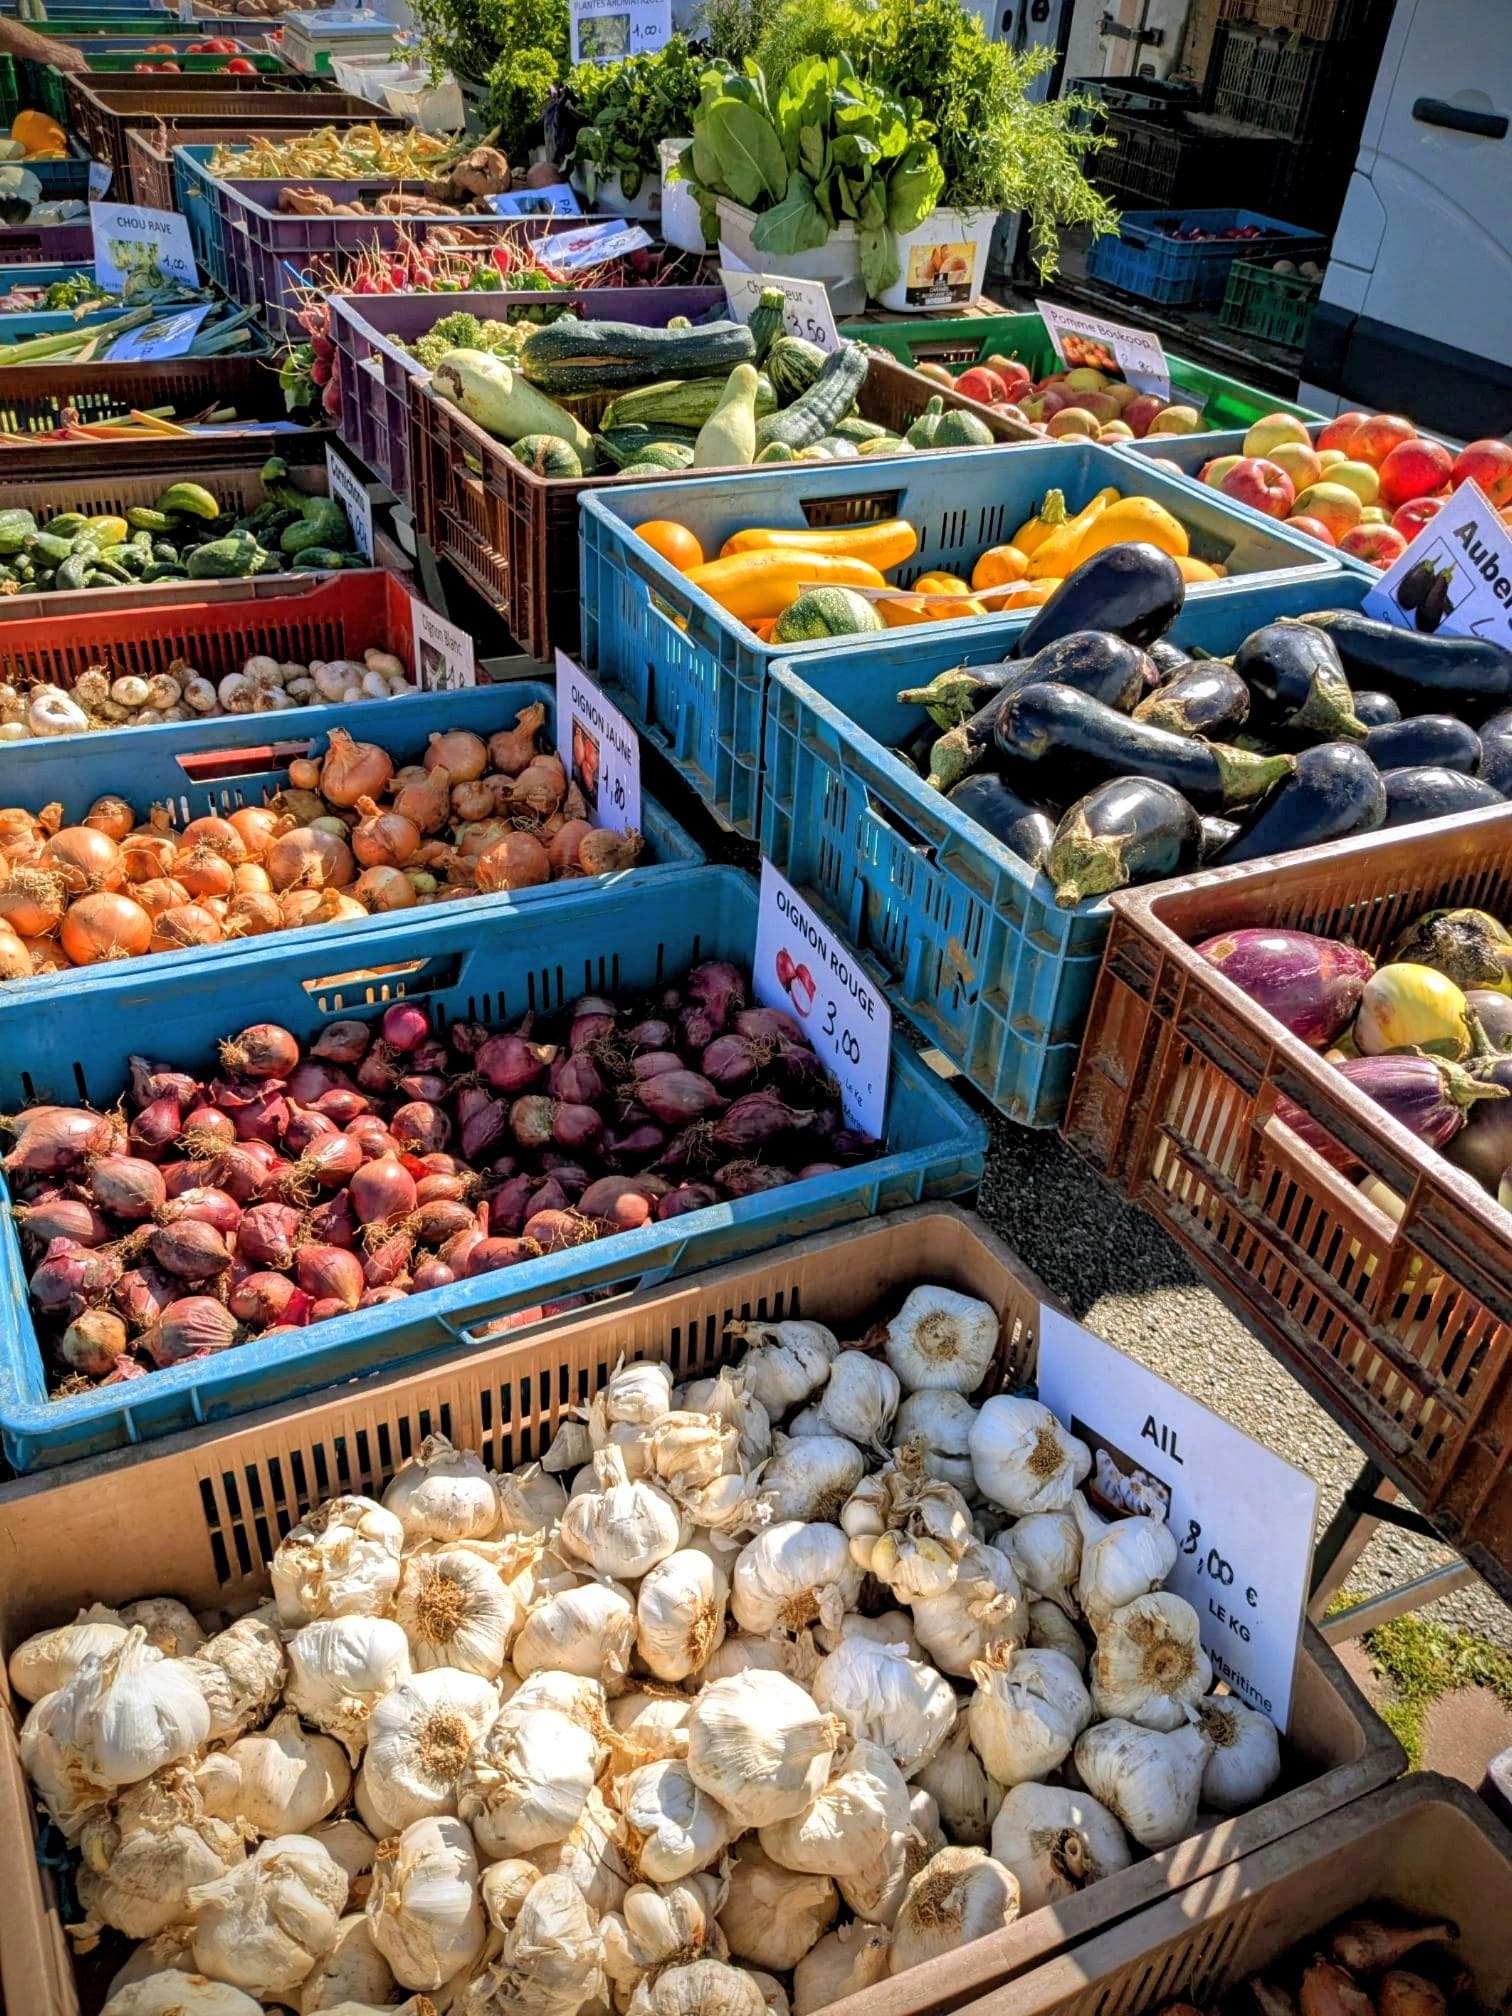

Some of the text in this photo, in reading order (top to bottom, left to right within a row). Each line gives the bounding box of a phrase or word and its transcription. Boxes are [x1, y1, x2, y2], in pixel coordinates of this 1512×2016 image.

[574, 0, 606, 10] PLANTES
[632, 24, 657, 39] 1,00
[117, 217, 172, 234] CHOU RAVE
[163, 255, 185, 270] 1,00
[1050, 311, 1151, 349] Pomme Boskoop
[422, 613, 462, 656] Oignon Blanc
[571, 685, 631, 767] OIGNON JAUNE
[602, 764, 625, 811] 1,80
[776, 890, 875, 1021] OIGNON ROUGE
[822, 1000, 861, 1065] 3,00
[1140, 1414, 1184, 1465] AIL
[1180, 1519, 1258, 1607] 8,00 €
[1208, 1598, 1251, 1643] LE KG
[1210, 1648, 1273, 1713] Maritime
